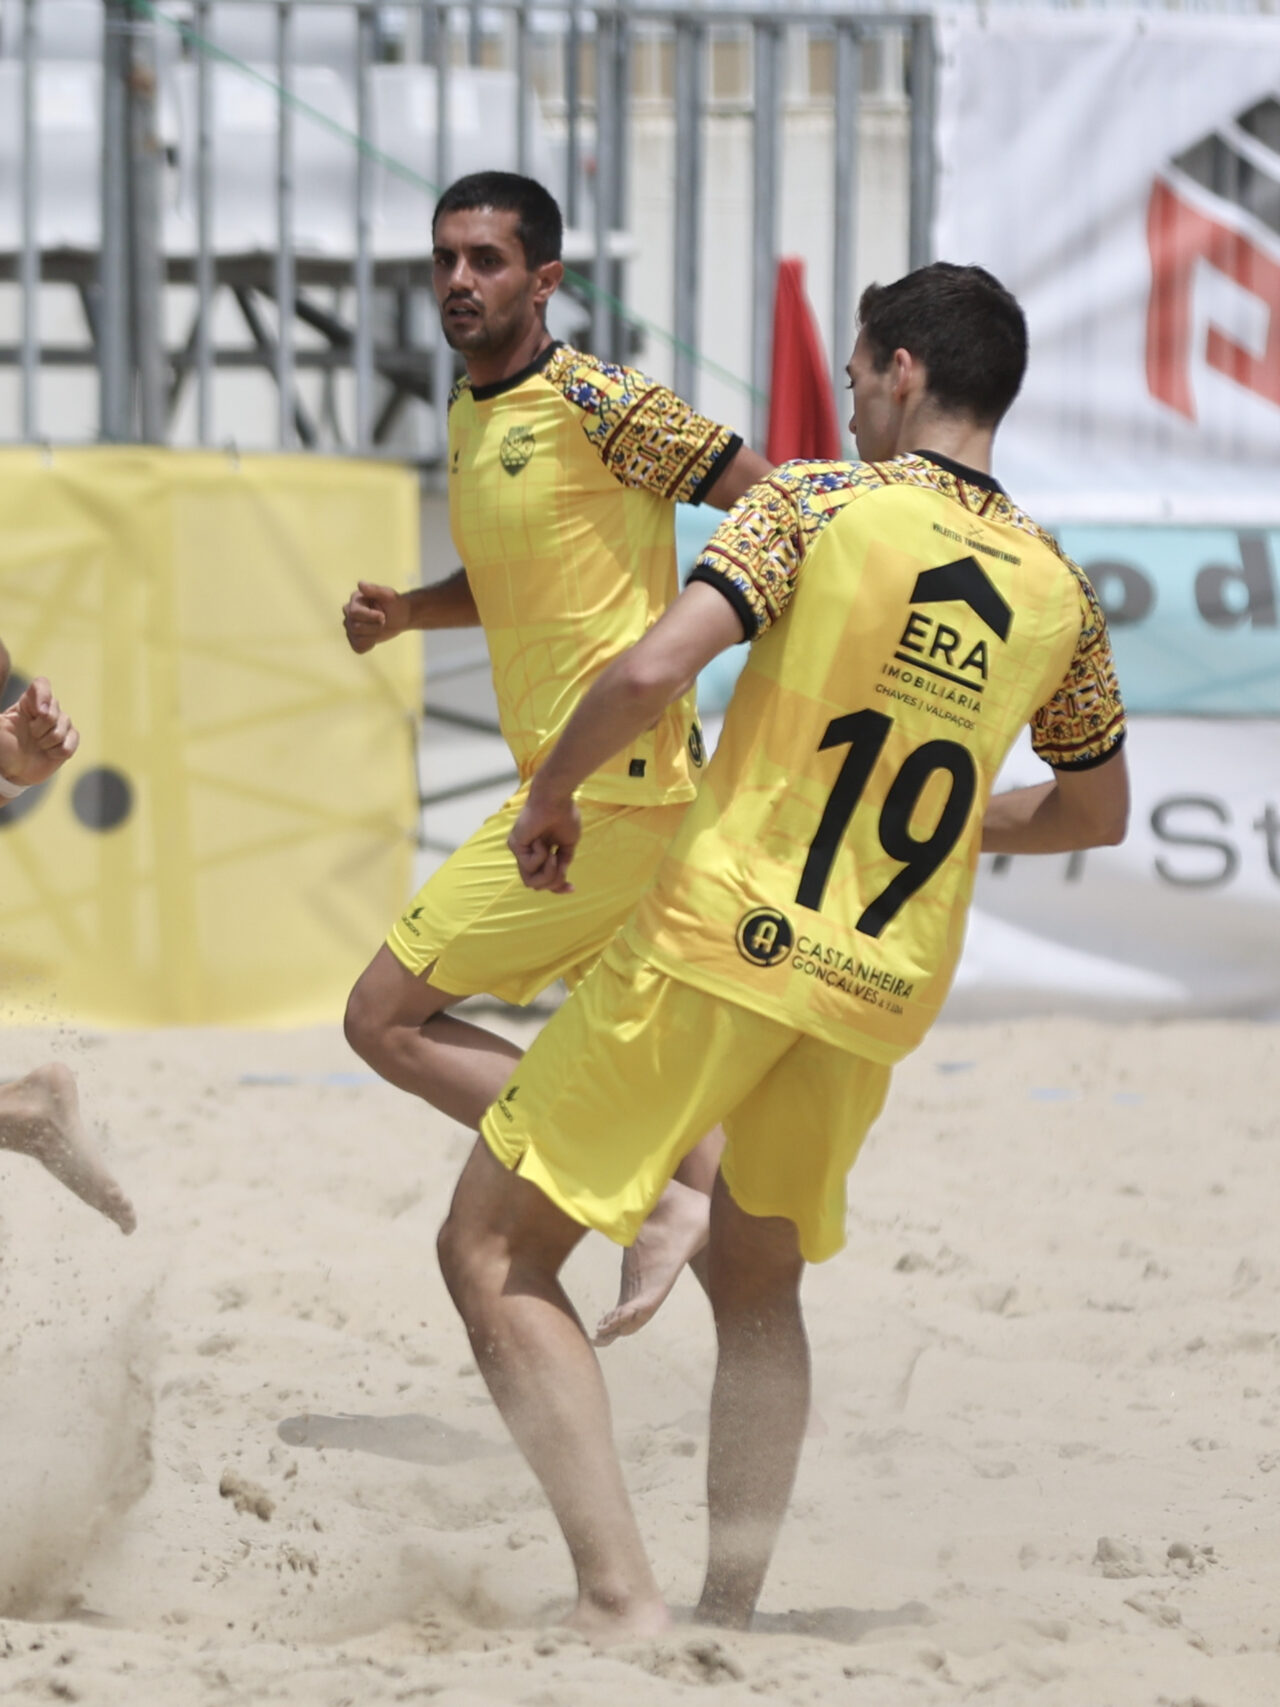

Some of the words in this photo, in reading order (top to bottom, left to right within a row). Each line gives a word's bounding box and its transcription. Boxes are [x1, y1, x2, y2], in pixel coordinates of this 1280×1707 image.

[899, 610, 989, 681] ERA
[874, 683, 918, 707] CHAVES
[925, 703, 976, 731] VALPAÇOS
[881, 663, 982, 713] IMOBILIÁRIA
[795, 707, 979, 939] 19
[791, 956, 879, 1004] GONÇALVES
[796, 936, 914, 999] CASTANHEIRA
